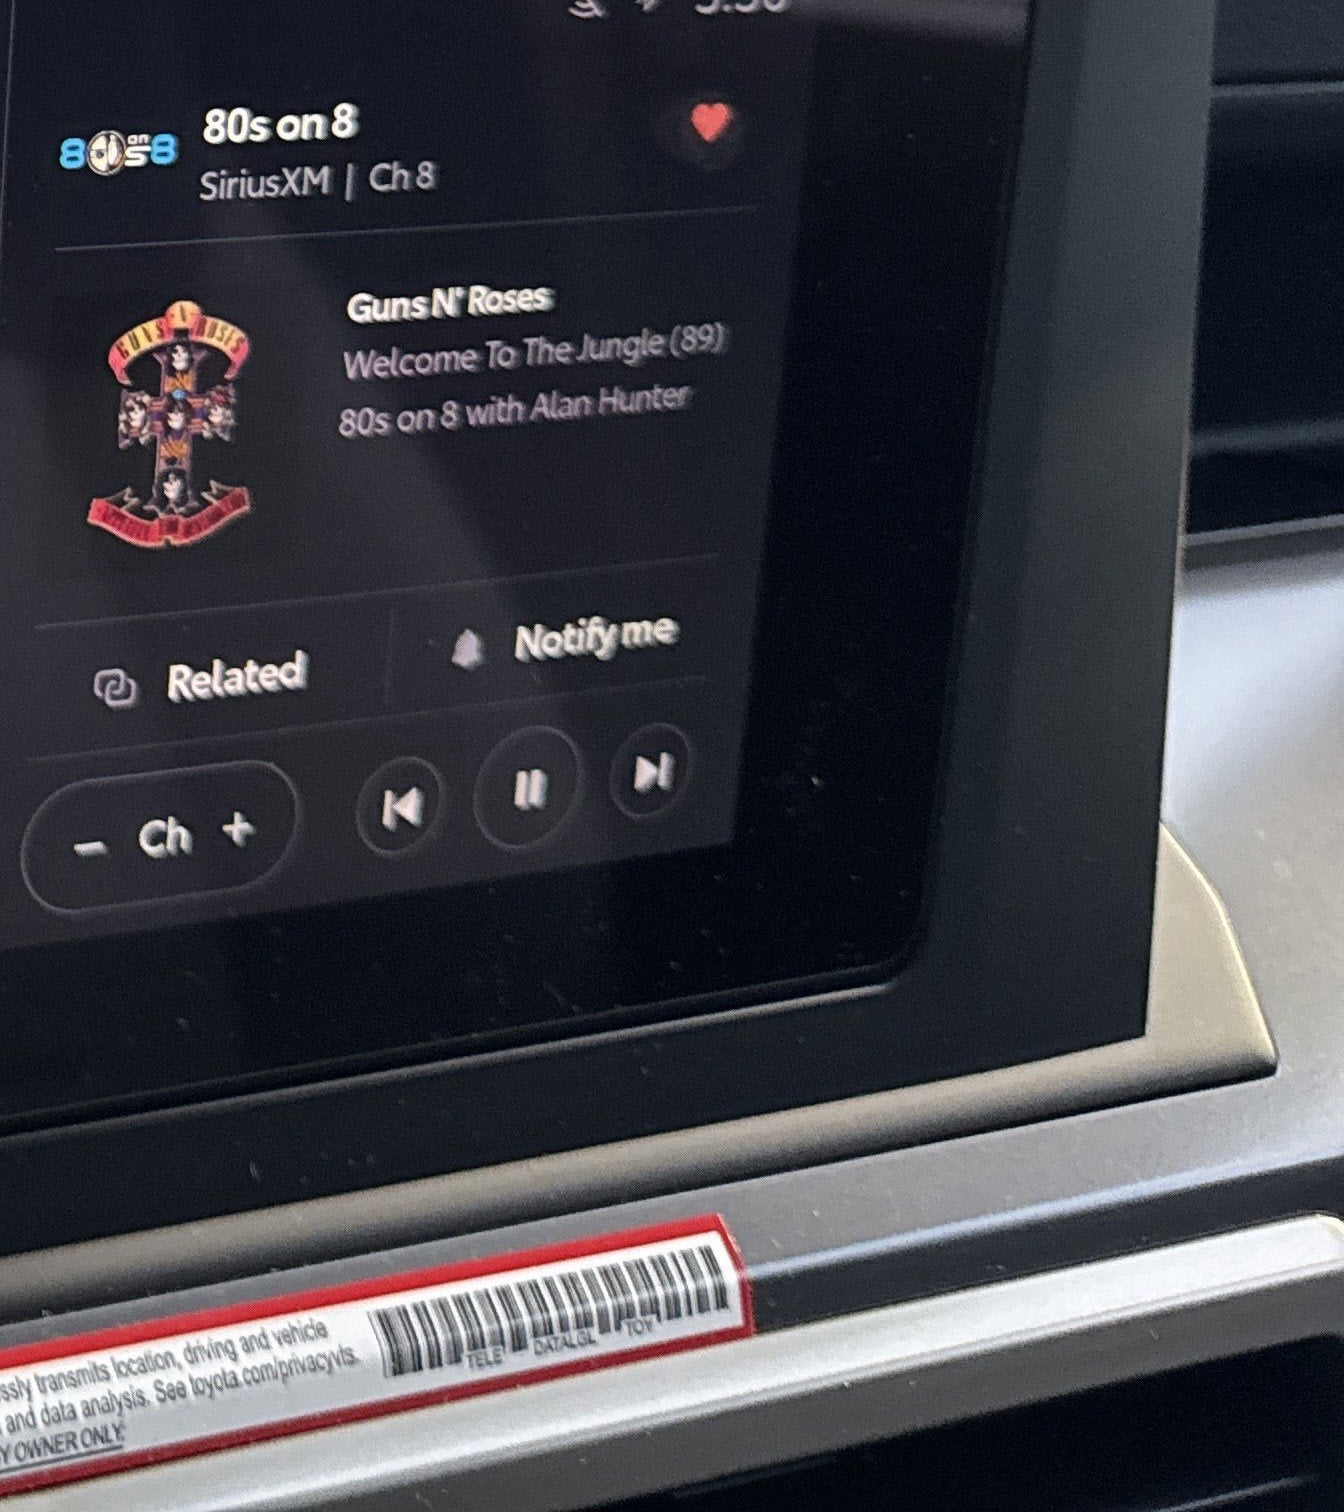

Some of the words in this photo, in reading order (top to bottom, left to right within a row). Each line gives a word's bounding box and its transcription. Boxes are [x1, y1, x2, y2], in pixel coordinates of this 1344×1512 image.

[202, 107, 272, 145] 80s
[276, 111, 327, 141] on
[331, 102, 360, 139] 8
[199, 165, 332, 202] SiriusXM
[370, 161, 413, 194] Ch
[415, 160, 439, 191] 8
[347, 292, 430, 323] Guns
[432, 286, 466, 317] N'
[468, 284, 556, 316] Roses
[343, 347, 484, 381] Welcome
[485, 340, 522, 370] To
[523, 336, 575, 366] The
[576, 328, 667, 367] Jungle
[669, 321, 727, 358] (89)
[338, 407, 392, 439] 80s
[397, 409, 437, 433] on
[439, 400, 459, 430] 8
[465, 394, 526, 426] with
[530, 390, 594, 422] Alan
[597, 384, 693, 416] Hunter
[515, 616, 619, 662] Notify
[620, 619, 679, 649] me
[167, 650, 309, 703] Related
[138, 815, 192, 859] Ch
[33, 1359, 111, 1396] transmits
[111, 1350, 183, 1380] location,
[183, 1337, 238, 1365] driving
[241, 1328, 272, 1351] and
[274, 1317, 329, 1347] vehicle
[5, 1404, 37, 1433] and
[40, 1396, 78, 1425] data
[81, 1384, 150, 1419] analysis.
[153, 1377, 187, 1404] See
[14, 1430, 79, 1462] OWNER
